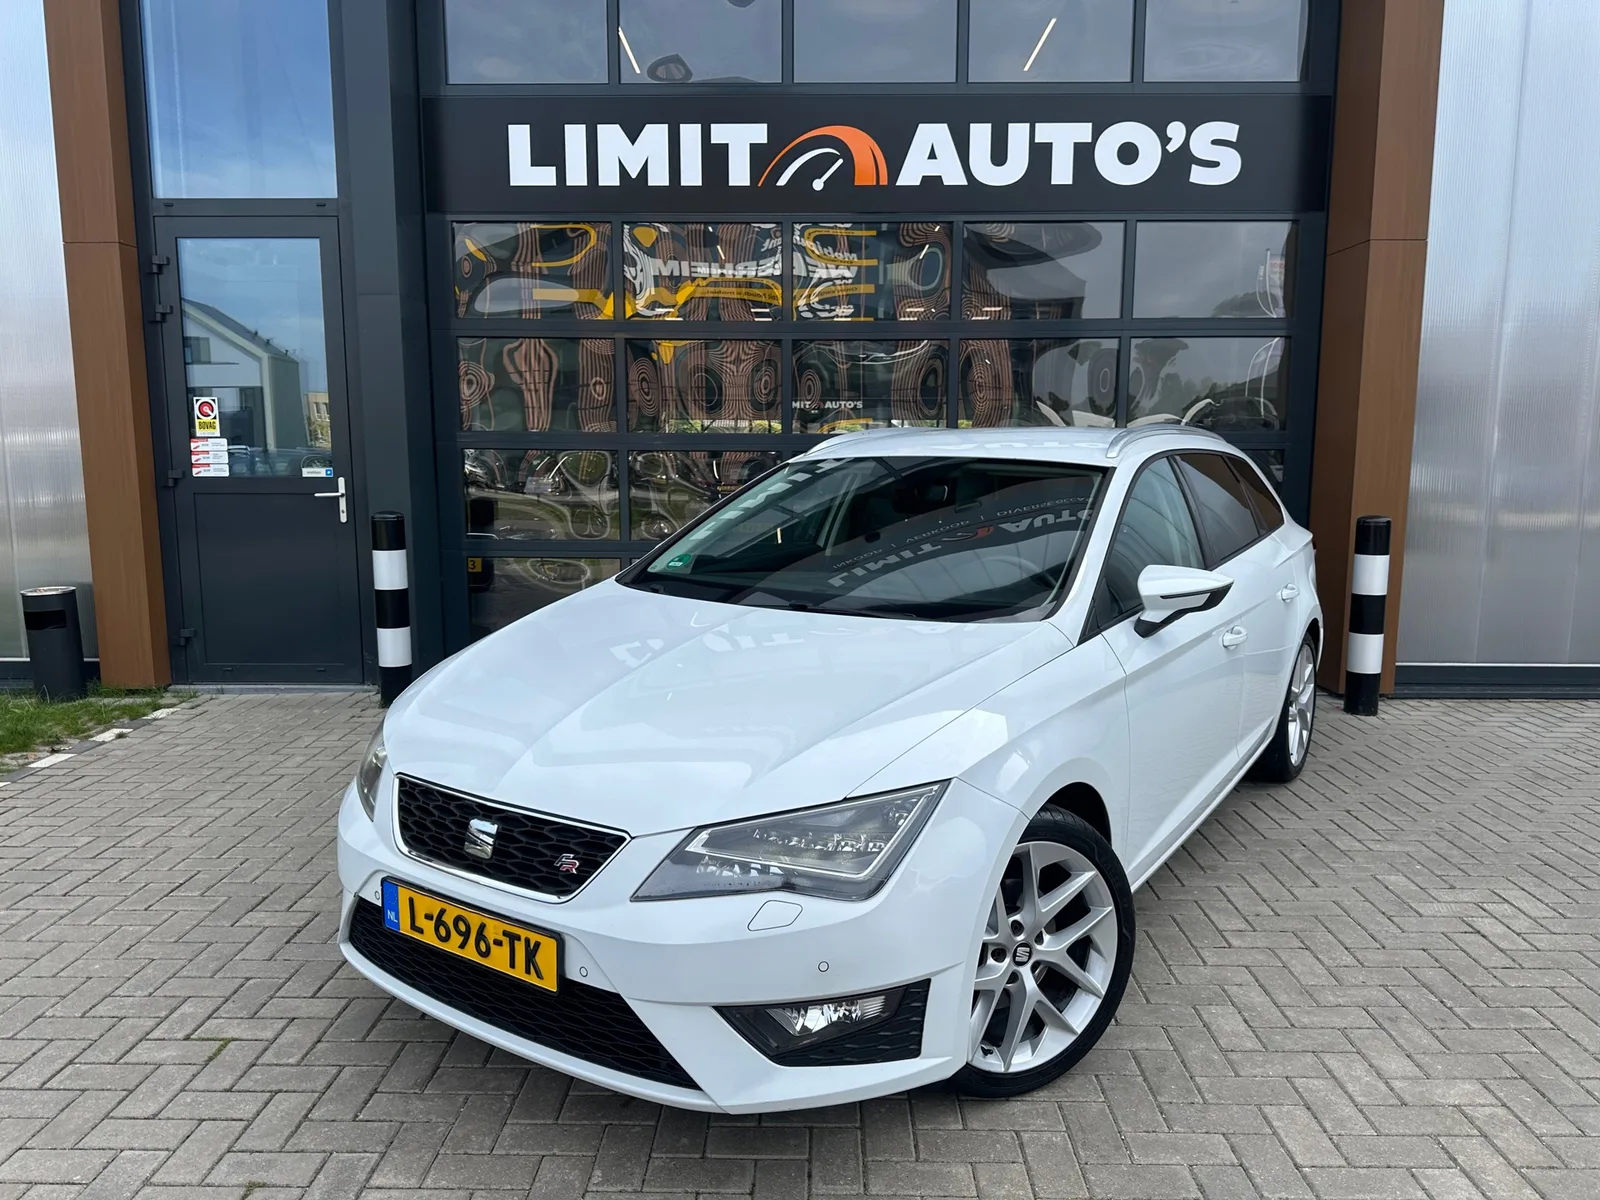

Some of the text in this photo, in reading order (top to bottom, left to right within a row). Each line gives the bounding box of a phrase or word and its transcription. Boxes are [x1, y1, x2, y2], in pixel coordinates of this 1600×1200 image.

[508, 124, 767, 186] LIMIT
[792, 401, 811, 409] MIT
[198, 421, 217, 430] BOVAG
[387, 910, 398, 923] NL
[408, 896, 544, 980] L-696-TK
